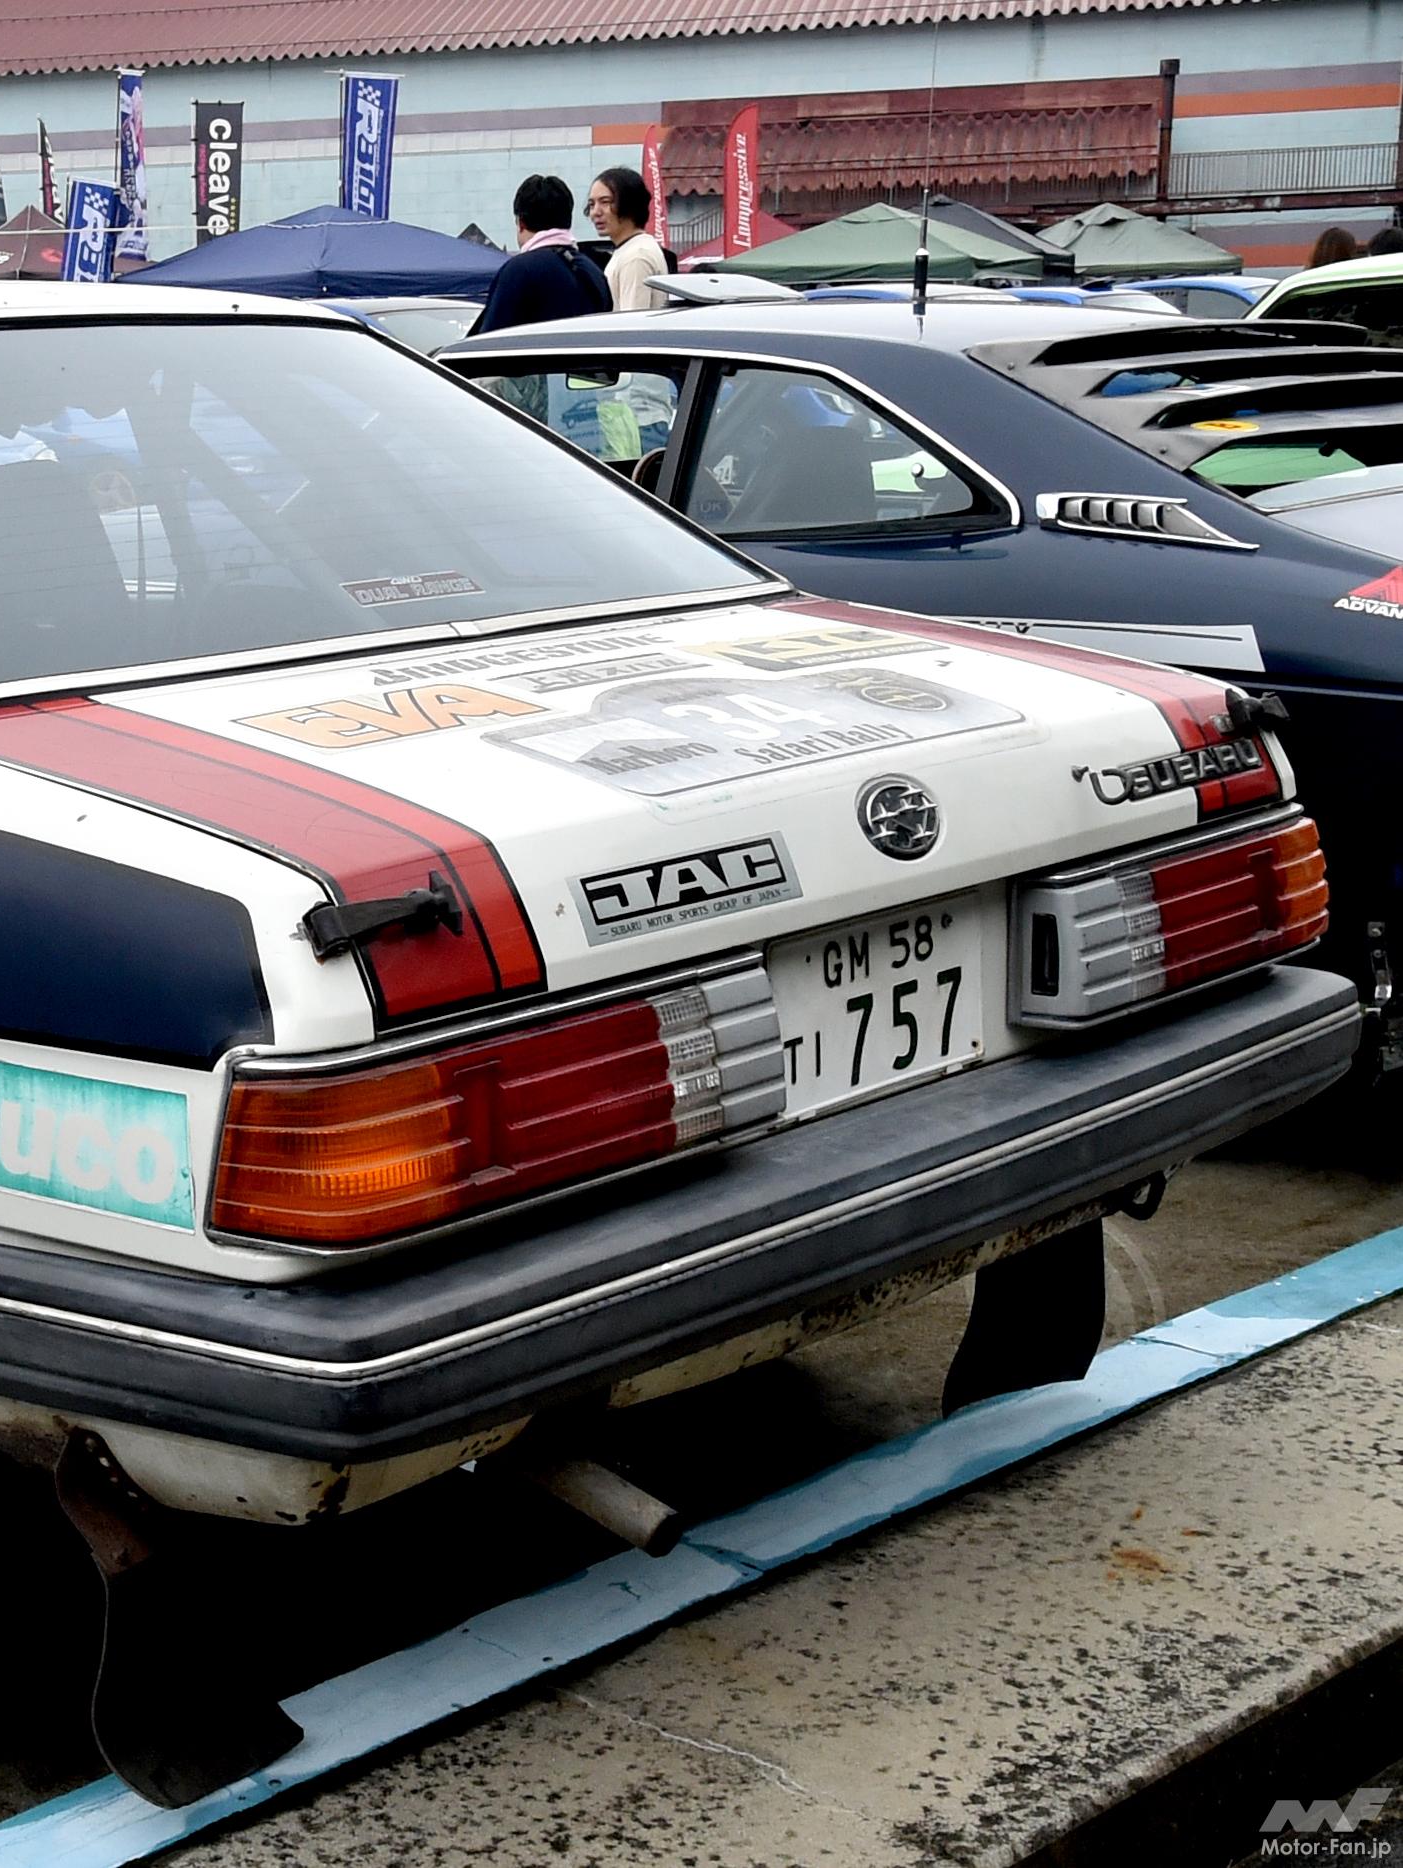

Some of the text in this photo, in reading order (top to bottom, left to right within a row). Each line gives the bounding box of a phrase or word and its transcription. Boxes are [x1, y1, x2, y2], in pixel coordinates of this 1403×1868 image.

[207, 119, 237, 236] cleave
[354, 578, 475, 603] DUAL RANGE
[229, 684, 550, 748] EVA
[662, 693, 839, 741] 34
[735, 720, 914, 766] Safari Rally
[579, 739, 718, 776] Marlboro
[1129, 737, 1263, 799] SUBARU
[585, 843, 784, 920] JAC
[610, 888, 782, 937] SUBARU MOTOR SPORTS GROUP OF JAPAN
[823, 915, 934, 988] GM 58
[846, 965, 962, 1087] 757
